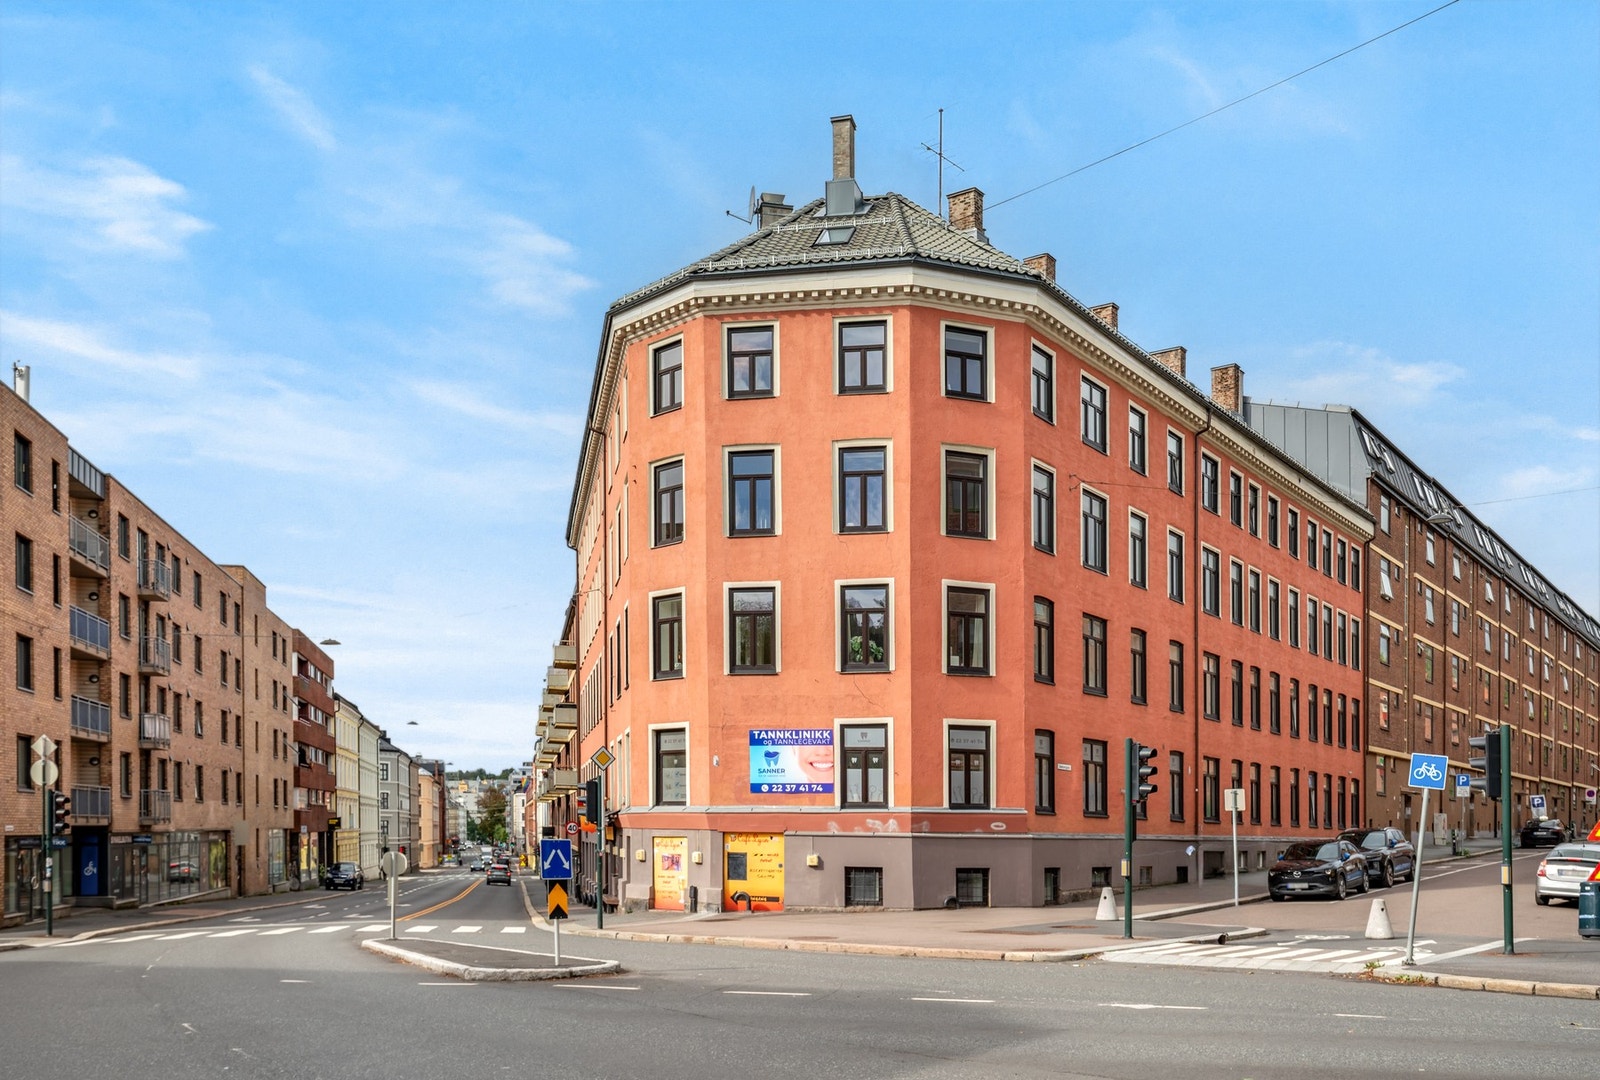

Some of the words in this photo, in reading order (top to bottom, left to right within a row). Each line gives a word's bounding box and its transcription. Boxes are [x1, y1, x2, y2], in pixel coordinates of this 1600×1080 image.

[753, 730, 831, 739] TANNKLINIKK
[1460, 775, 1467, 785] P
[771, 784, 783, 792] 22
[785, 784, 796, 792] 37
[799, 784, 809, 792] 41
[811, 784, 823, 792] 74
[1534, 799, 1541, 807] P
